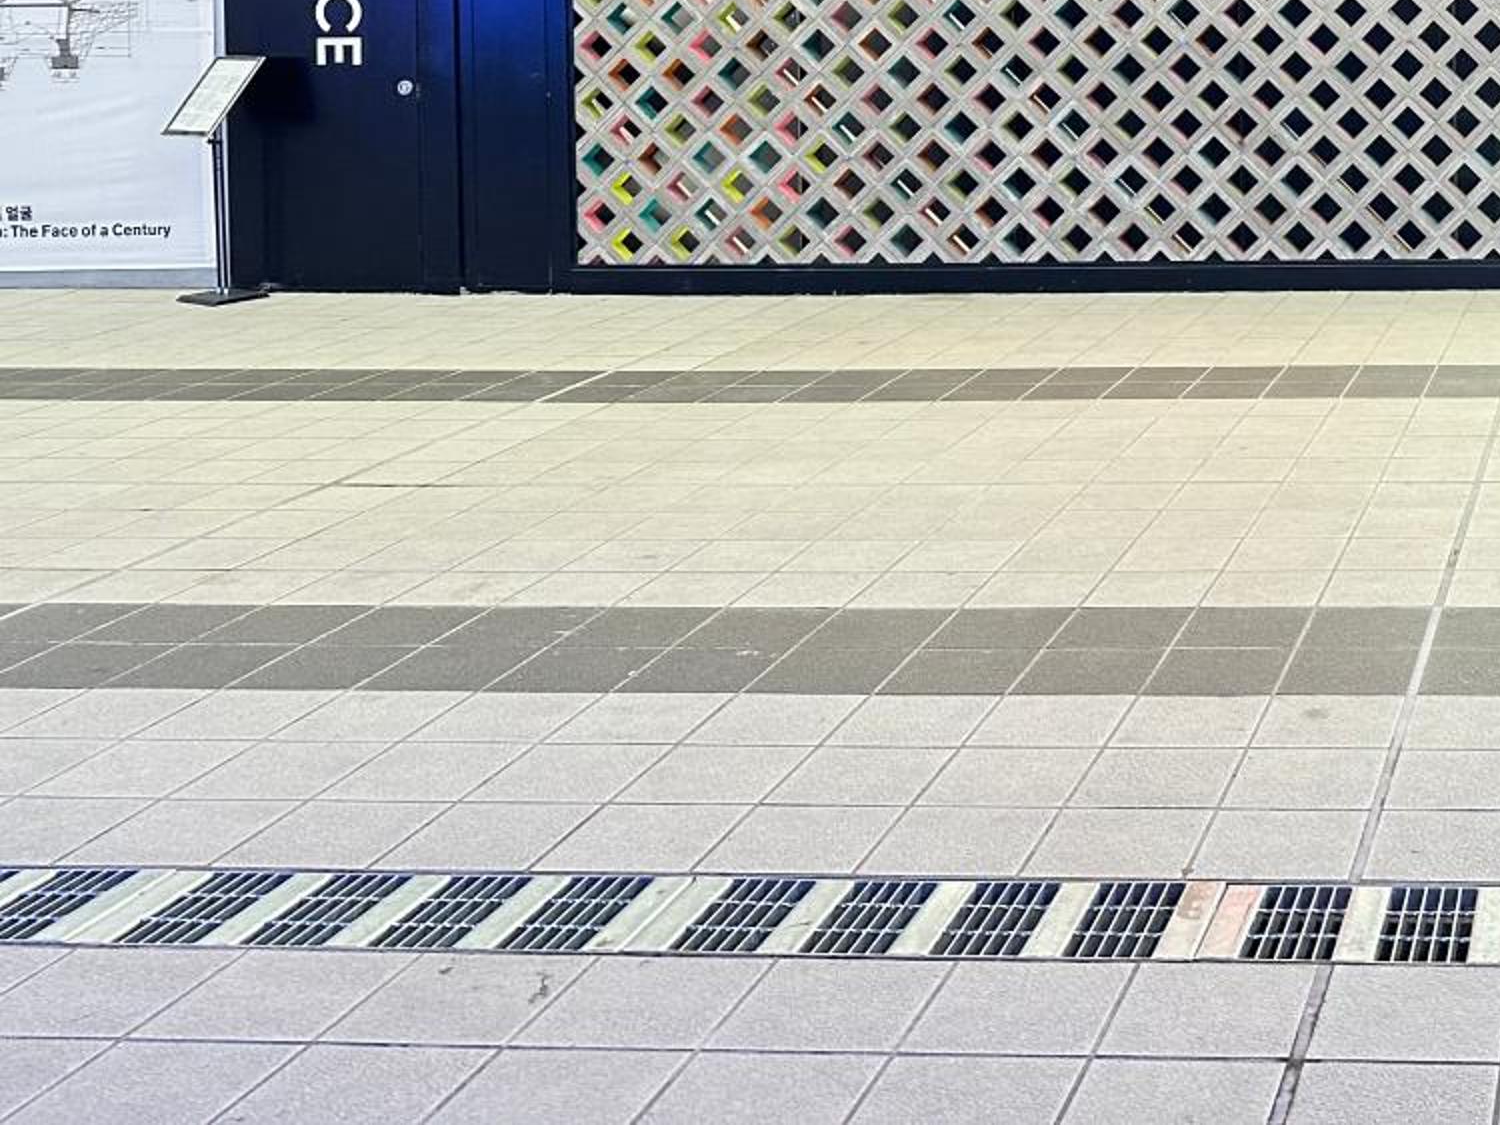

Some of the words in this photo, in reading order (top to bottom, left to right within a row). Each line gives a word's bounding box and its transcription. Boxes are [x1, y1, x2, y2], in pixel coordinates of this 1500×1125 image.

[11, 225, 38, 238] The
[41, 224, 78, 237] Face
[81, 223, 97, 237] of
[99, 225, 109, 237] a
[112, 223, 171, 238] Century
